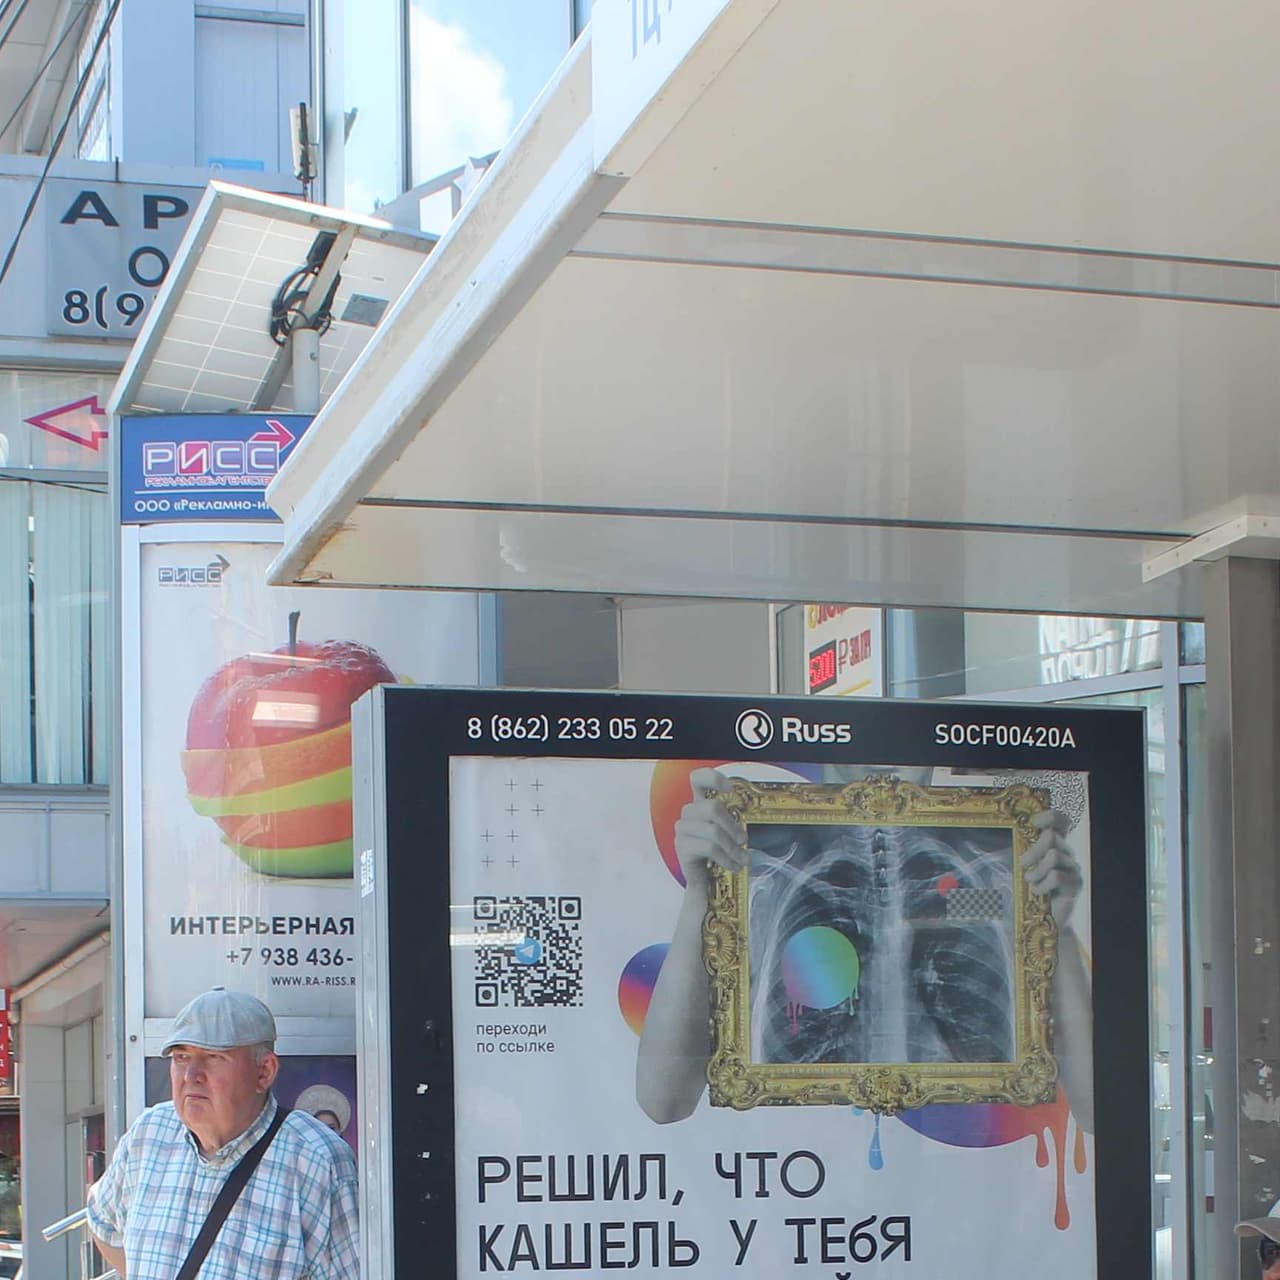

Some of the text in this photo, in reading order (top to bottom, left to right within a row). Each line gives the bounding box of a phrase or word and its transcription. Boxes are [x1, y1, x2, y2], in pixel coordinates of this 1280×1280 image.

[60, 190, 189, 229] АР
[128, 246, 170, 288] О
[62, 285, 145, 329] 8(9
[145, 445, 277, 473] РИСС
[134, 499, 269, 513] ООО «Рекламно-и
[159, 569, 222, 582] РИСС
[467, 714, 674, 742] 8 (862) 233 05 22
[782, 717, 852, 743] Russ
[935, 723, 1076, 749] SOCF00420A
[170, 916, 355, 936] ИНТЕРЬЕРНАЯ
[227, 948, 354, 966] +7 938 436-
[271, 976, 356, 987] WWW.RA-RISS.R
[476, 1024, 547, 1038] переходи
[476, 1042, 555, 1053] по ссылке
[478, 1150, 826, 1205] РЕШИЛ, ЧТО
[478, 1220, 701, 1272] КАШЕЛЬ
[729, 1218, 758, 1266] У
